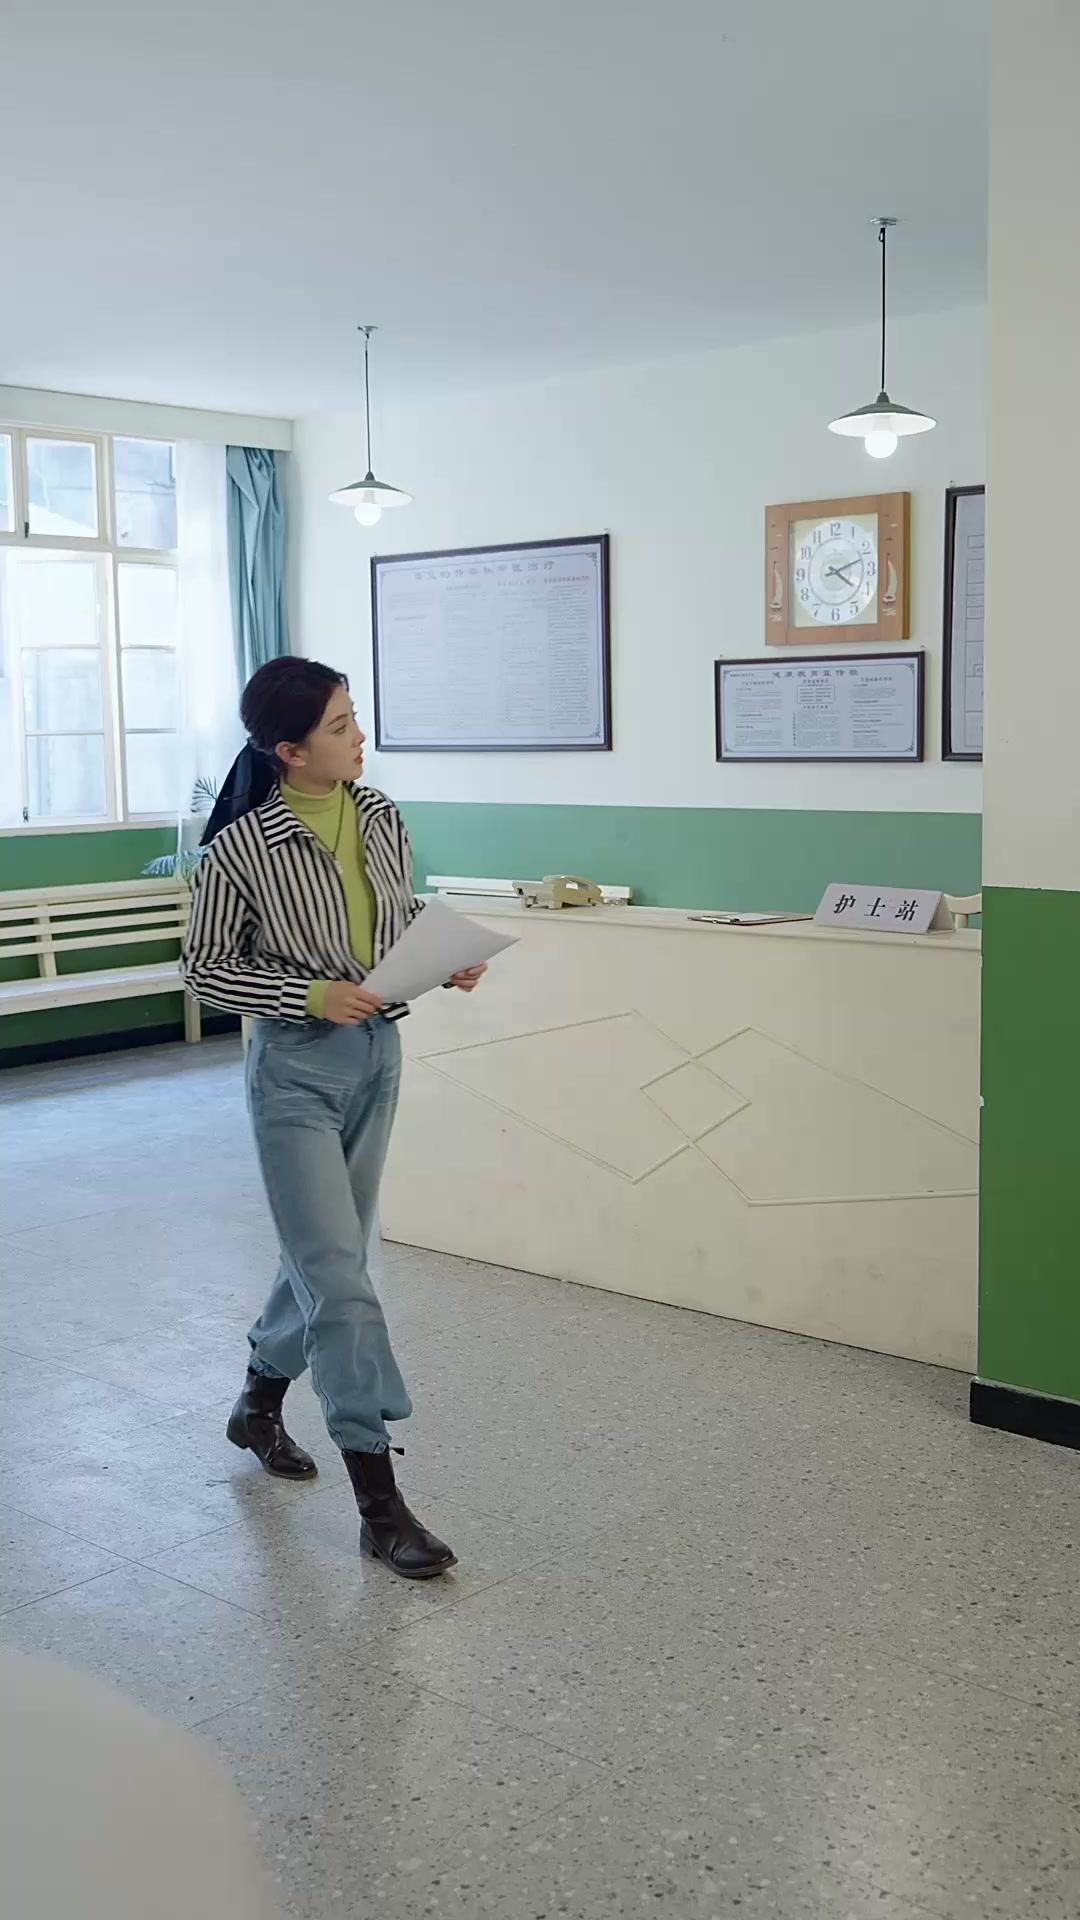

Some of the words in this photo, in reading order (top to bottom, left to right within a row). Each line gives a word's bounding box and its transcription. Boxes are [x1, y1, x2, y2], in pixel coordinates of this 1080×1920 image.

[830, 522, 840, 536] 12
[812, 530, 821, 544] 11
[801, 546, 811, 560] 10
[861, 540, 871, 555] 2
[796, 568, 805, 581] 9
[867, 562, 876, 576] 3
[801, 588, 809, 601] 8
[812, 603, 821, 617] 7
[831, 608, 840, 621] 6
[850, 601, 859, 615] 5
[833, 894, 919, 921] 护士站
